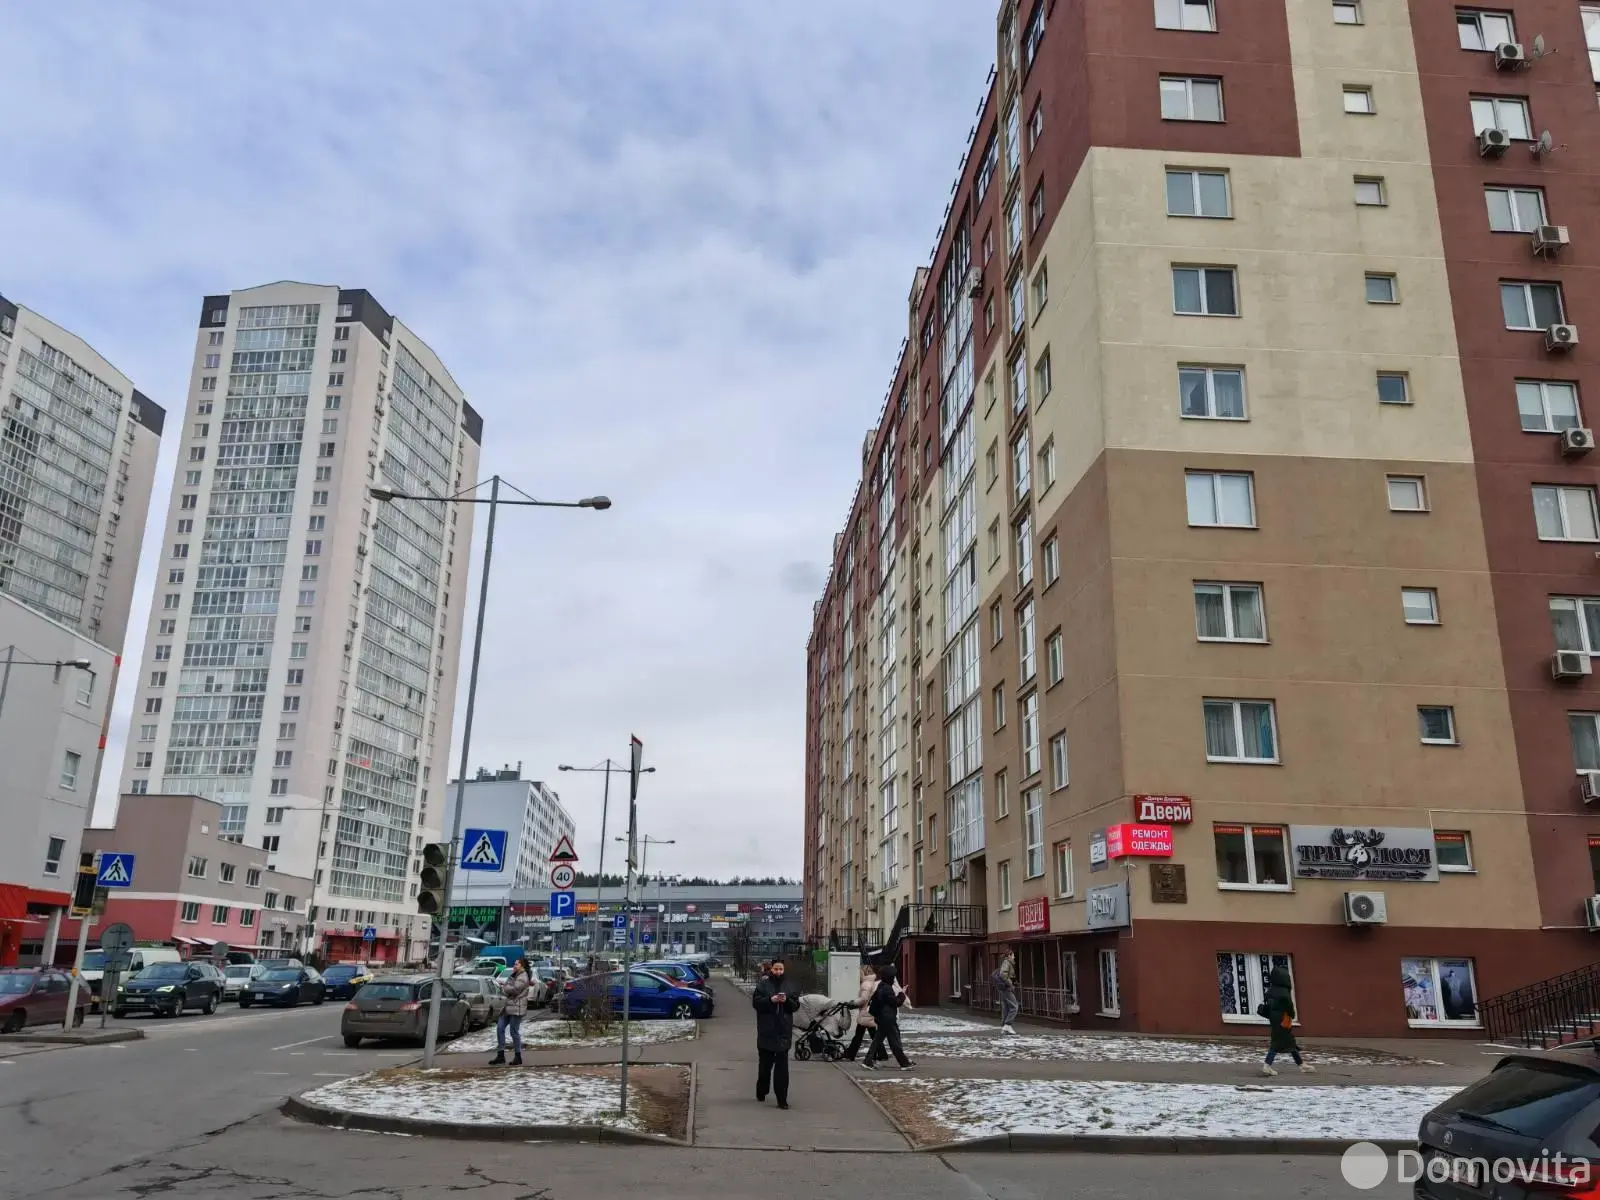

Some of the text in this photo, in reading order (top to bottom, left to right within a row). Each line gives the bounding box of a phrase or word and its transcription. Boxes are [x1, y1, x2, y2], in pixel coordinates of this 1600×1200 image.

[1139, 802, 1191, 821] Двери
[1132, 829, 1169, 839] РЕМОНТ
[1131, 841, 1172, 851] ОДЕЖДЫ
[1297, 845, 1432, 864] ТРИ ЛОСЯ
[556, 872, 570, 882] 40
[557, 894, 571, 914] P
[617, 915, 625, 926] P
[1019, 902, 1044, 927] ДВЕРИ
[1237, 954, 1248, 1014] РЕМОНТ
